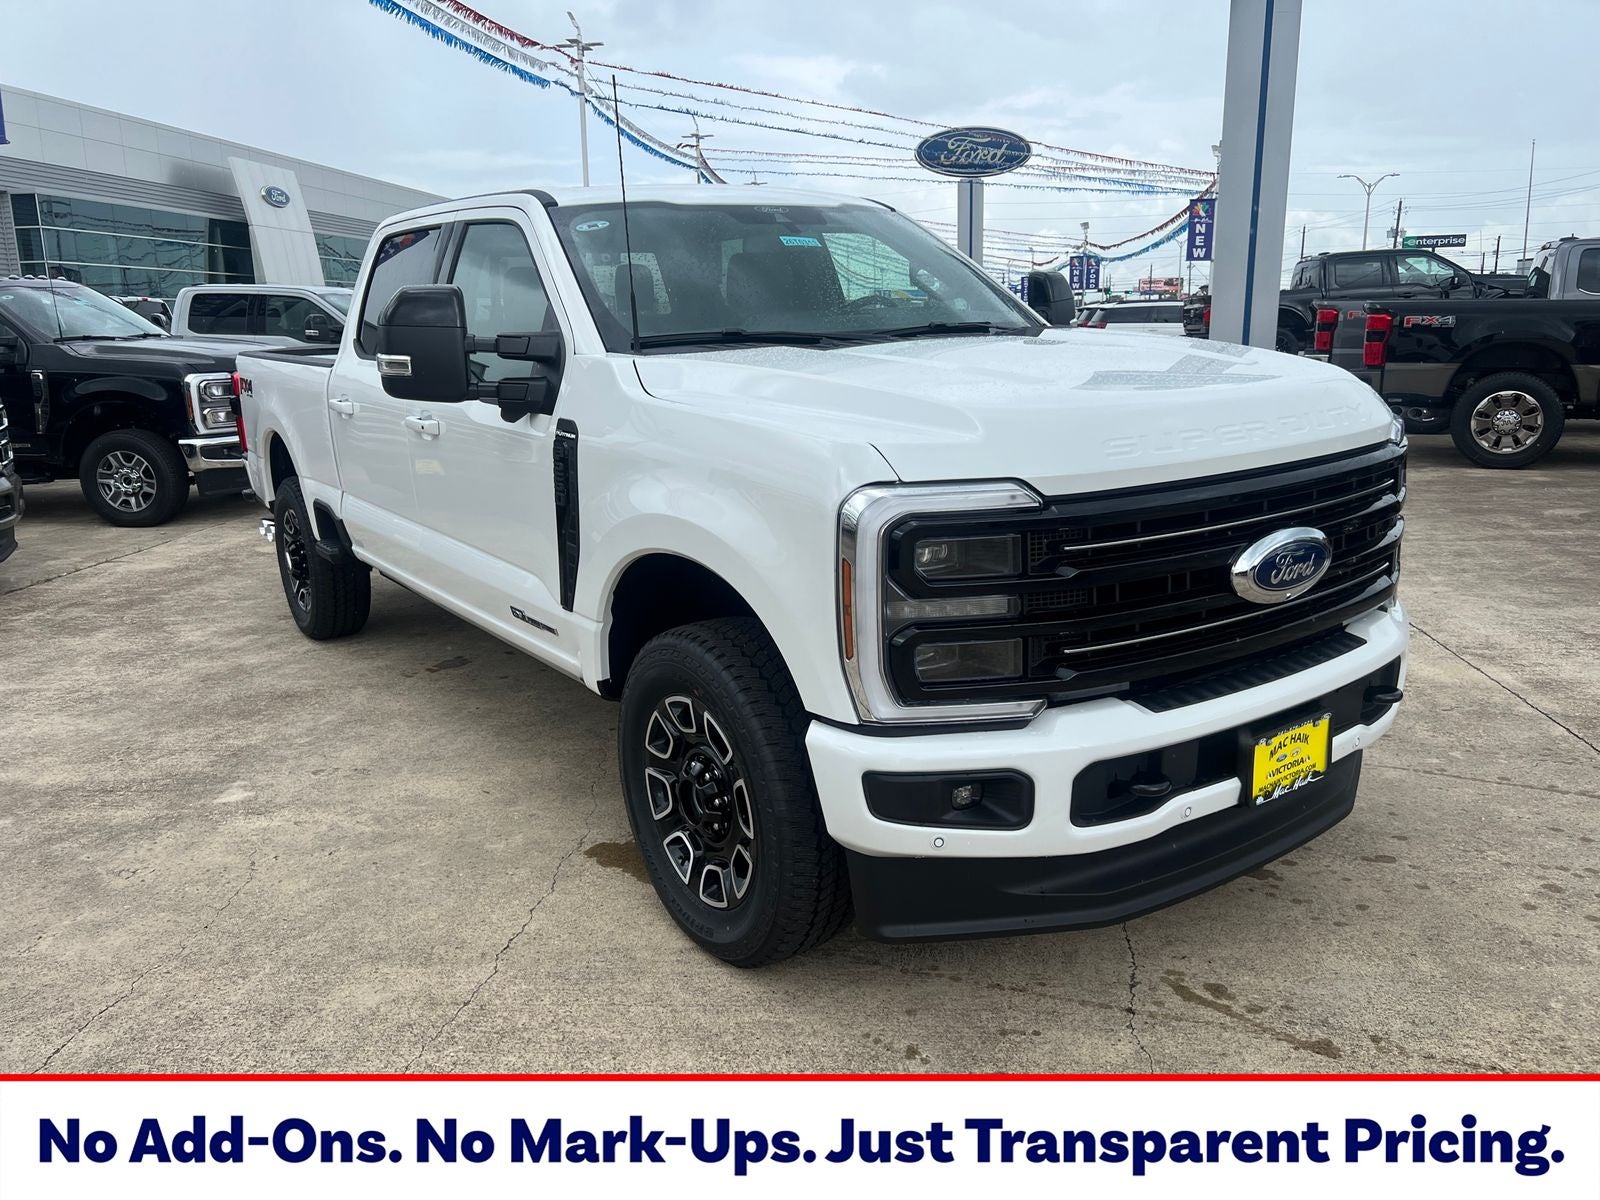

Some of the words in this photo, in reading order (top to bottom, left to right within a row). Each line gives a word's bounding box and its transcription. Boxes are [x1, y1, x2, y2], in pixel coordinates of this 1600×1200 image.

[940, 136, 1007, 164] Ford
[271, 189, 286, 202] Ford
[1192, 223, 1206, 258] NEW
[1408, 236, 1465, 247] enterprise
[1072, 269, 1080, 289] NEW
[1403, 315, 1456, 328] FX4
[1102, 419, 1276, 460] SUPER
[1276, 402, 1367, 435] DUTY
[1270, 549, 1315, 585] Ford
[1268, 736, 1289, 761] MAC
[1289, 732, 1310, 745] HAIK
[1269, 757, 1305, 778] VICTORIA
[1271, 784, 1292, 799] Mac
